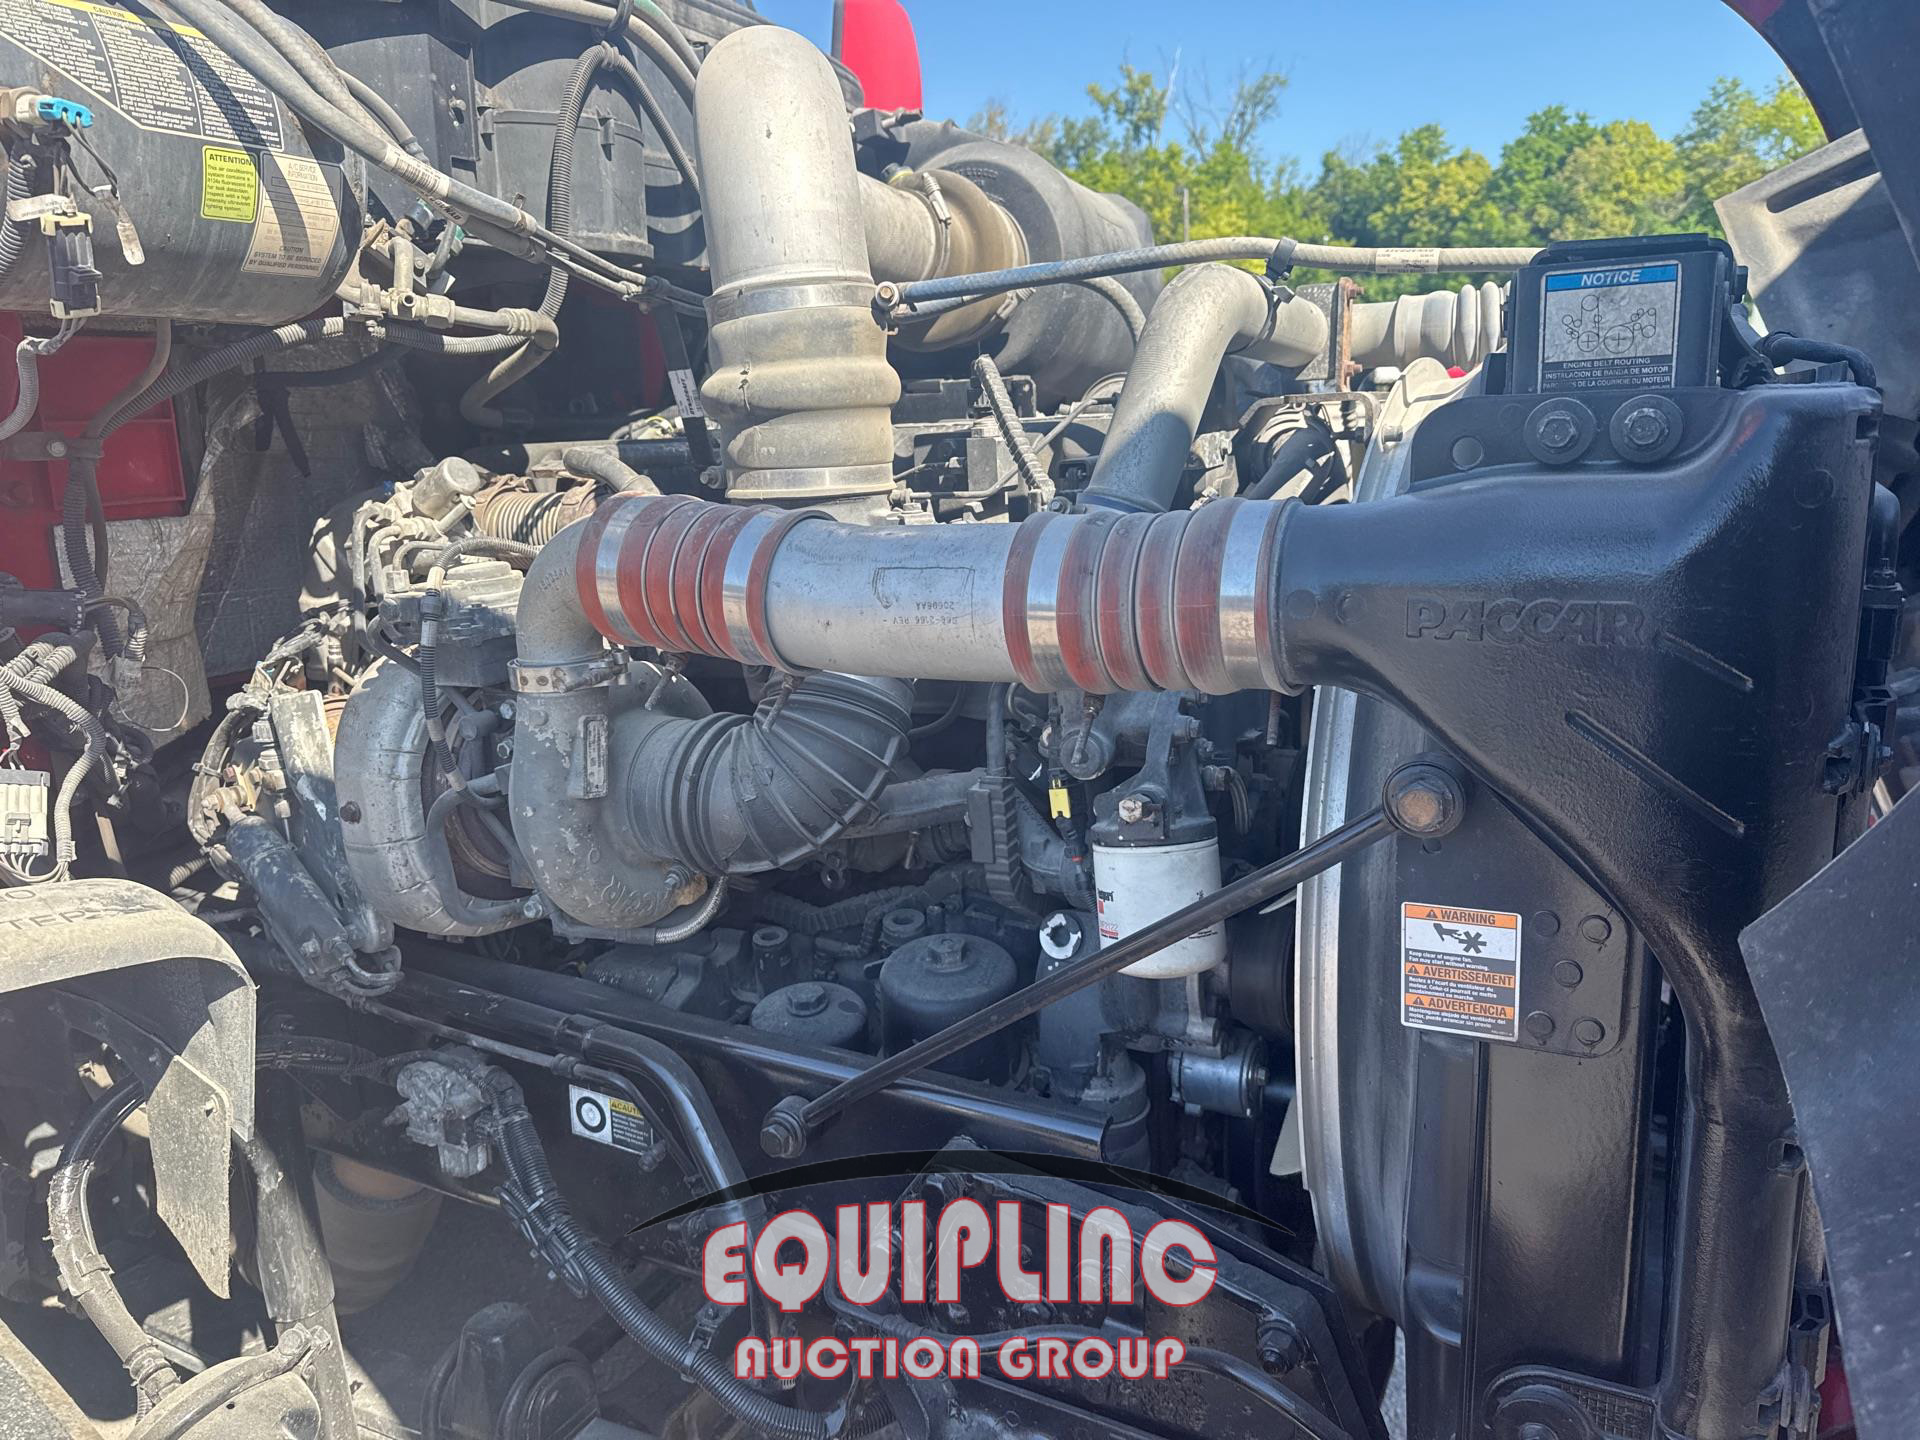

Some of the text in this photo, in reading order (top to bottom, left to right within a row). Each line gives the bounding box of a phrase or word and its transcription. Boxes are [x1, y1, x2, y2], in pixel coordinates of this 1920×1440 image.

[93, 6, 125, 18] CAUTION
[209, 153, 252, 166] ATTENTION
[1581, 270, 1642, 287] NOTICE
[1563, 361, 1592, 369] ENGINE
[1614, 358, 1651, 366] ROUTING
[1641, 366, 1669, 374] MOTOR
[1587, 379, 1596, 387] LA
[1642, 376, 1671, 384] MOTEUR
[1406, 597, 1648, 647] PACCAR
[1440, 909, 1496, 925] WARNING
[1409, 950, 1422, 958] Keep
[1443, 954, 1460, 962] engine
[1445, 960, 1465, 968] without
[1423, 965, 1513, 986] AVERTISSEMENT
[1428, 997, 1508, 1017] ADVERTENCIA
